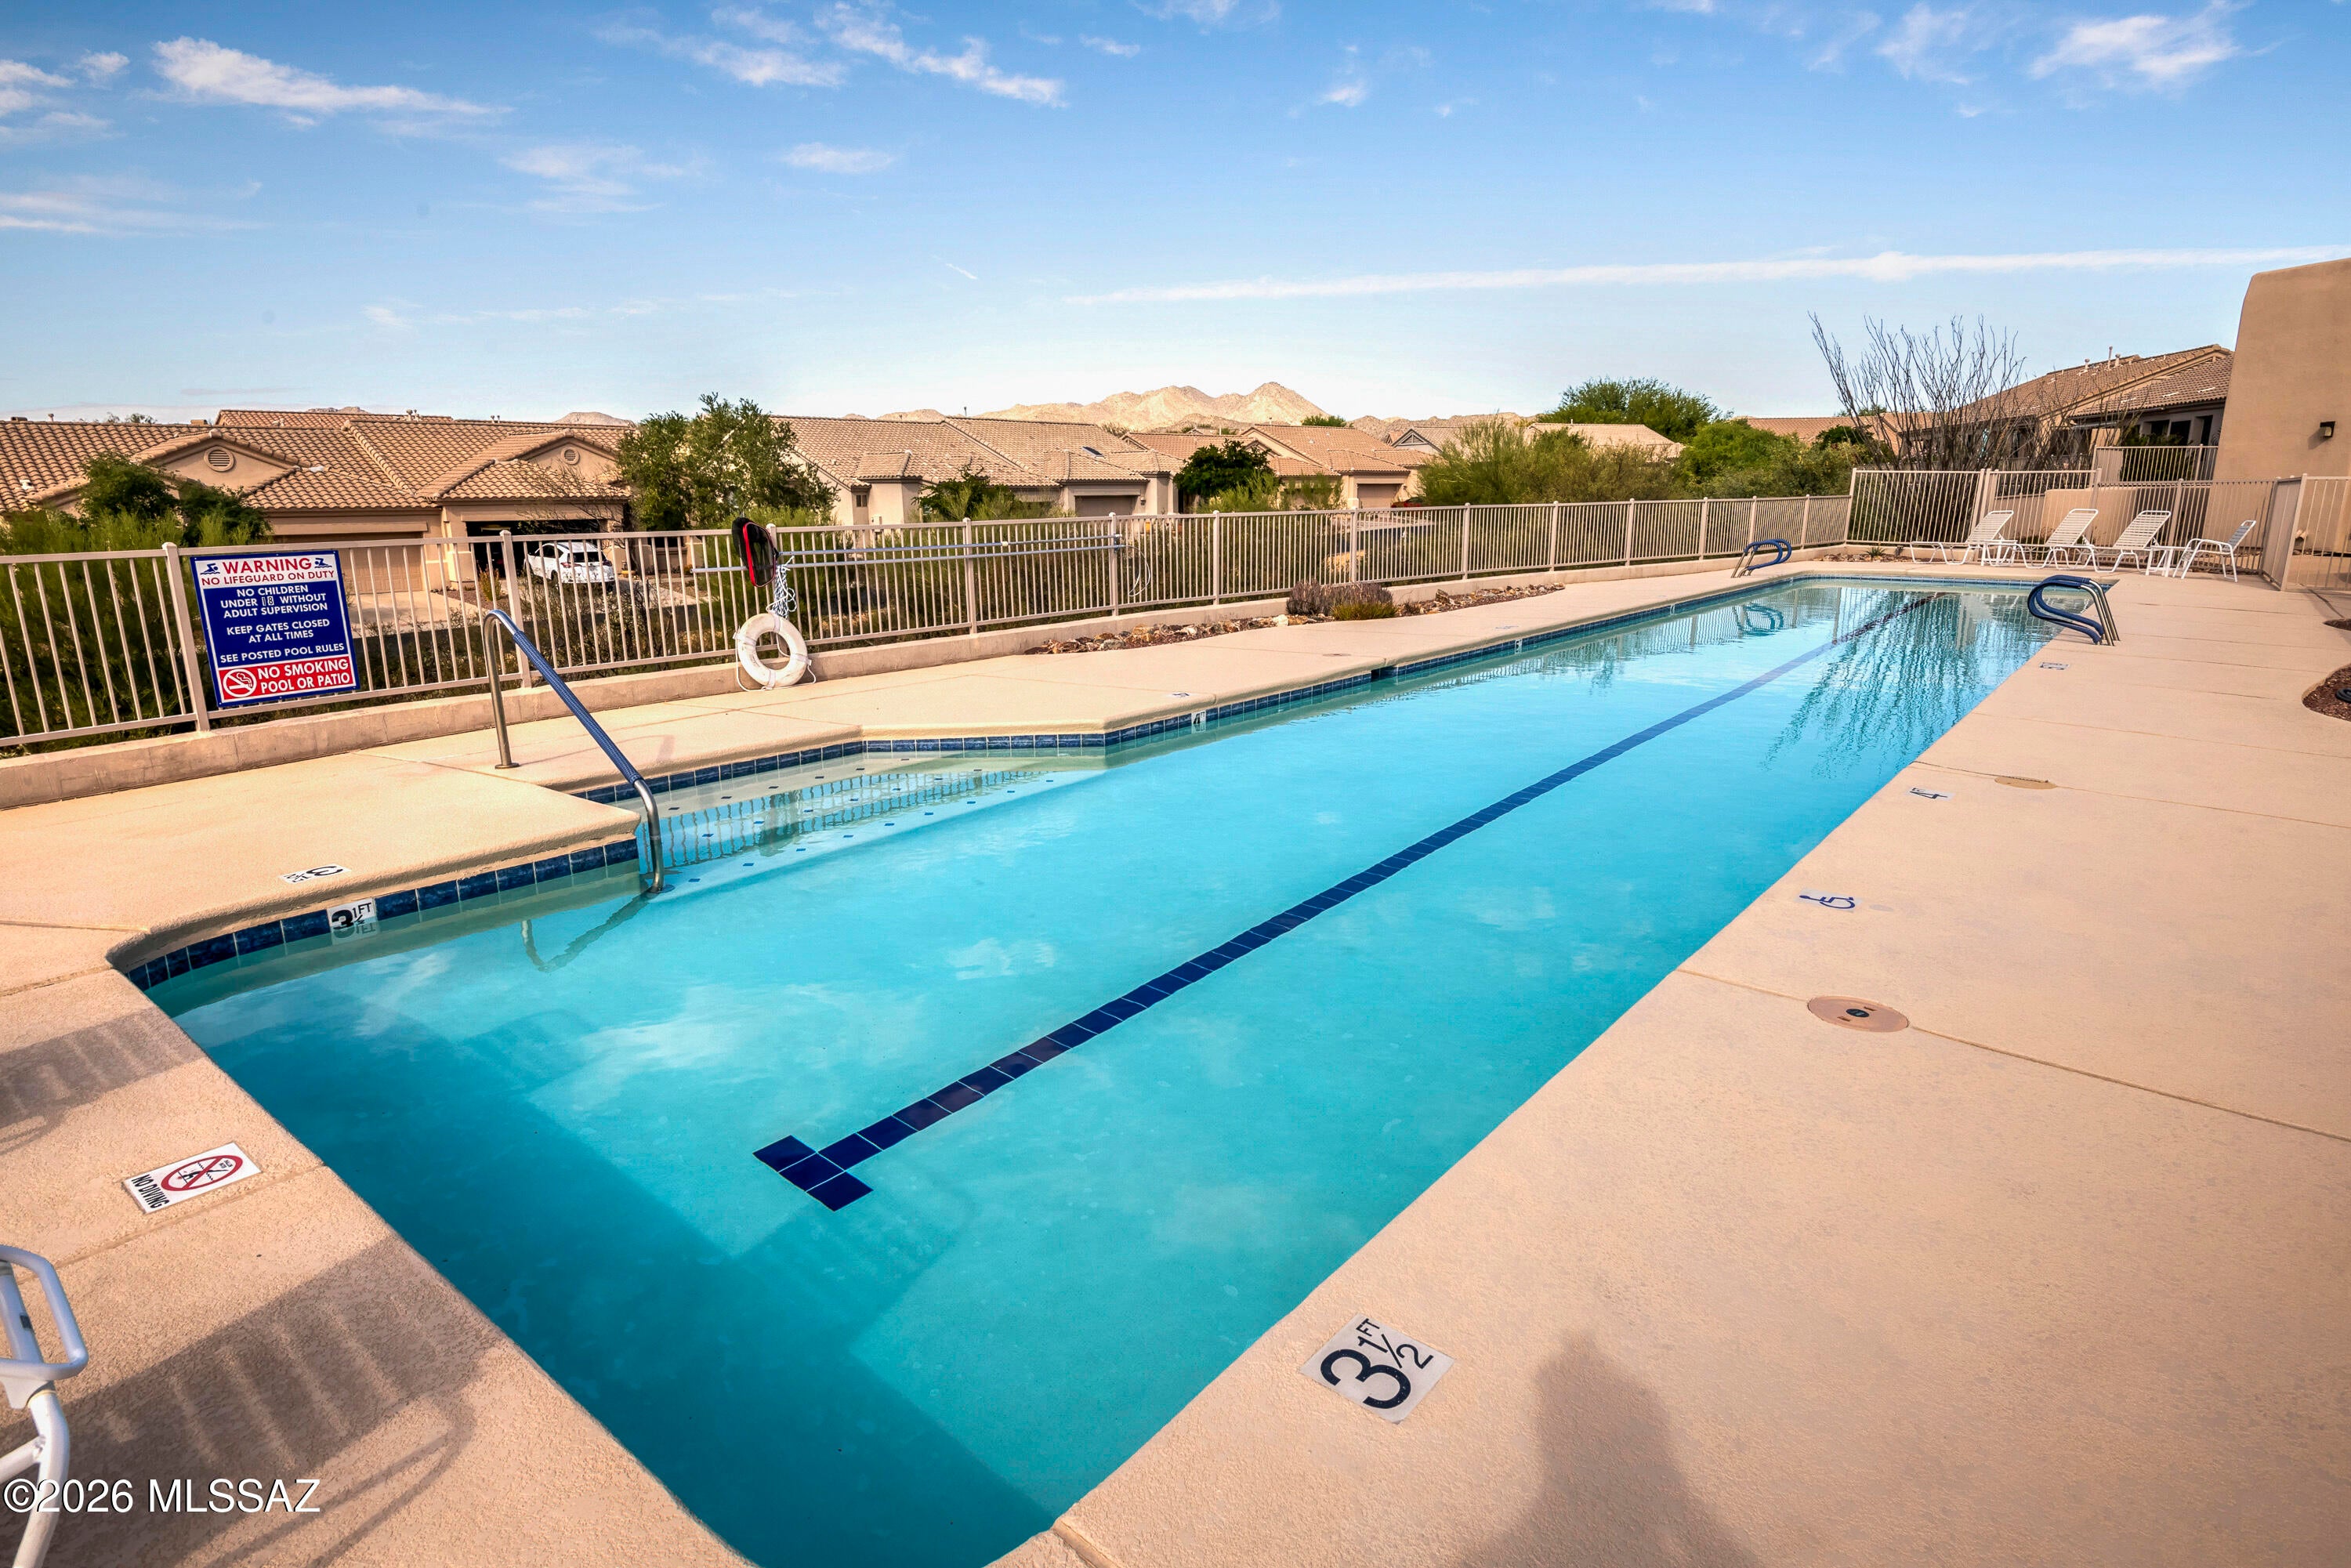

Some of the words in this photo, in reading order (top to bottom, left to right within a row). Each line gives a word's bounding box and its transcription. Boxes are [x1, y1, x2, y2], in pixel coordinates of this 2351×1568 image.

[223, 557, 312, 574] WARNING
[201, 577, 220, 586] NO
[224, 573, 284, 585] LIFEGUARD
[237, 588, 255, 597] NO
[258, 585, 309, 596] CHILDREN
[220, 599, 258, 609] UNDER
[262, 596, 273, 606] 18
[280, 593, 326, 604] WITHOUT
[223, 608, 257, 618] ADULT
[261, 603, 328, 615] SUPERVISION
[226, 626, 252, 636] KEEP
[256, 623, 288, 632] GATES
[292, 618, 330, 629] CLOSED
[248, 635, 261, 643] AT
[264, 633, 283, 642] ALL
[284, 630, 313, 640] TIMES
[220, 654, 238, 663] SEE
[242, 650, 281, 661] POSTED
[284, 646, 313, 657] POOL
[316, 643, 344, 653] RULES
[257, 666, 280, 679] NO
[284, 658, 349, 676] SMOKING
[260, 679, 294, 693] POOL
[296, 676, 314, 688] OR
[317, 672, 350, 686] PATIO
[131, 1174, 154, 1187] NO
[138, 1183, 170, 1208] DIVING
[1356, 1318, 1380, 1337] FT
[1320, 1349, 1411, 1410] 3
